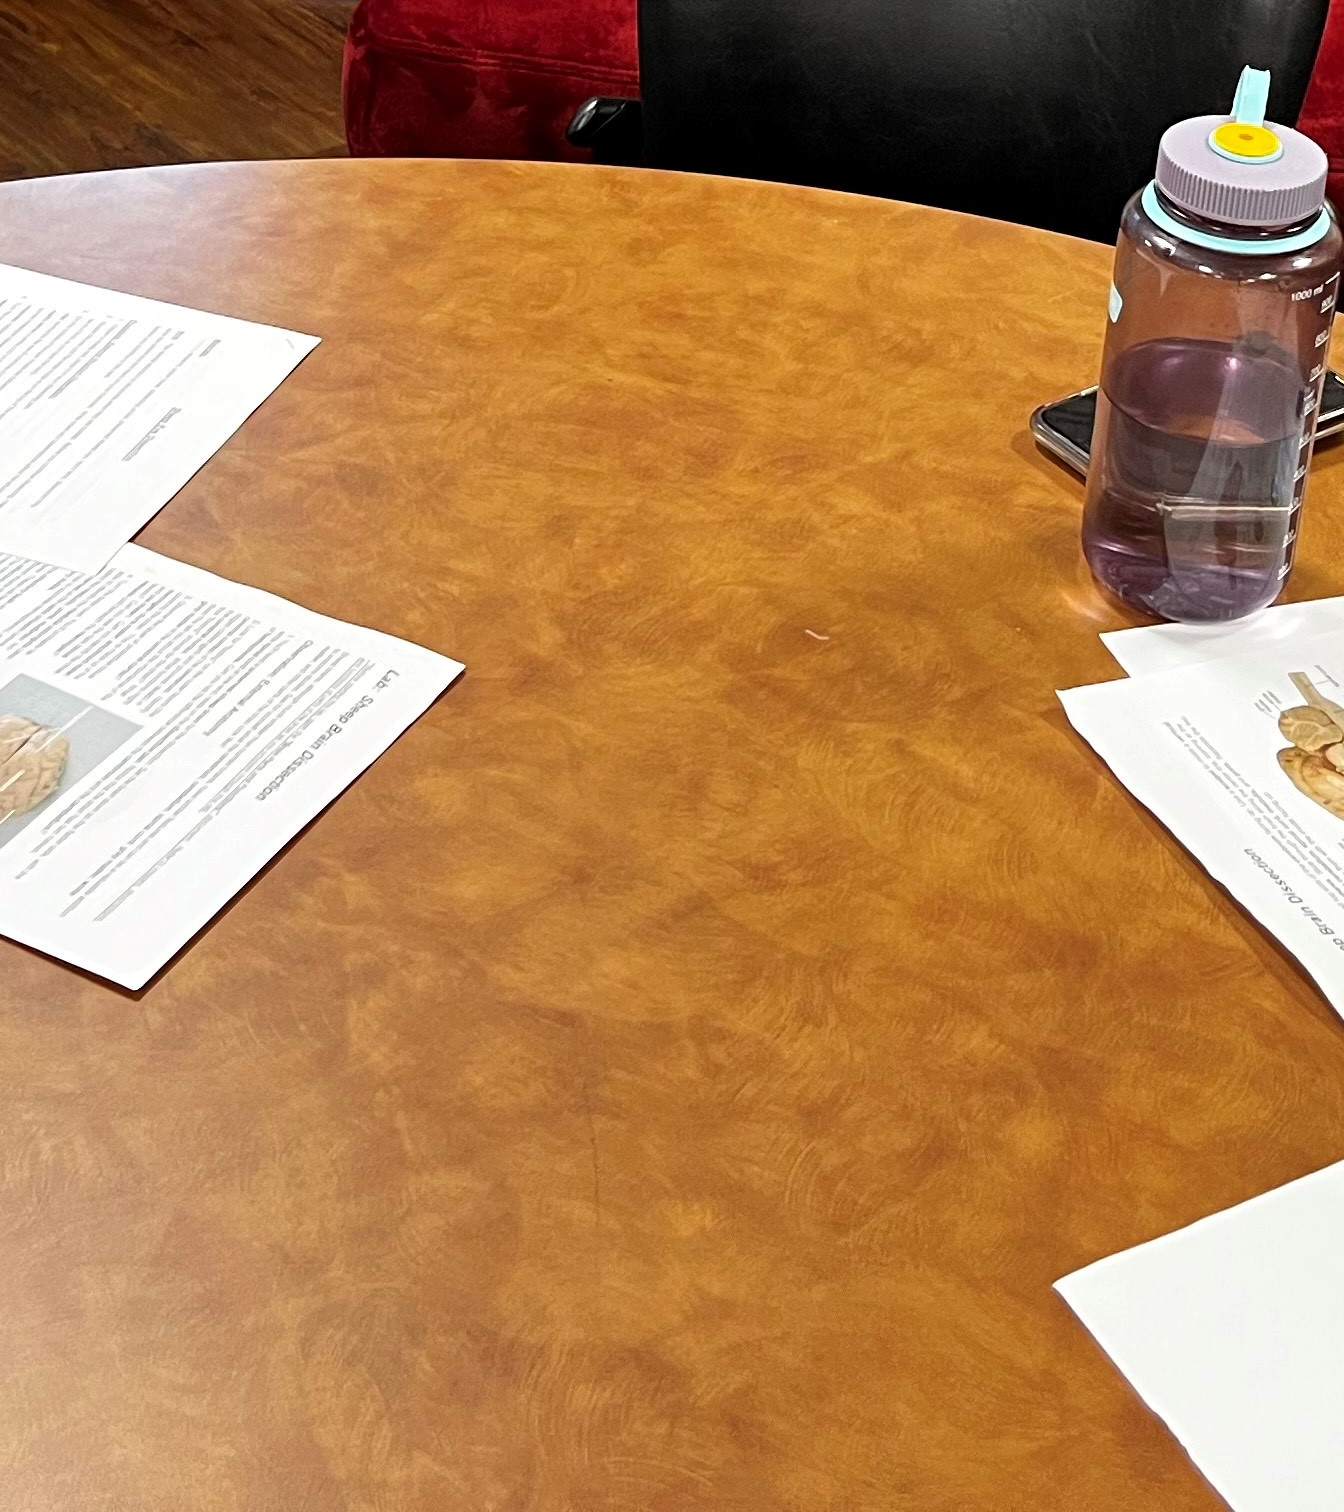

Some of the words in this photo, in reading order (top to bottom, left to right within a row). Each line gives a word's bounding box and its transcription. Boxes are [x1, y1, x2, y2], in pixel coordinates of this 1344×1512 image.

[1290, 287, 1313, 303] 1000
[1312, 283, 1324, 297] ml
[371, 668, 401, 690] Lab:
[337, 694, 375, 725] Sheep
[309, 722, 343, 751] Brain
[254, 748, 315, 802] Dissection
[1242, 847, 1304, 905] Dissection
[1299, 905, 1336, 936] Brain
